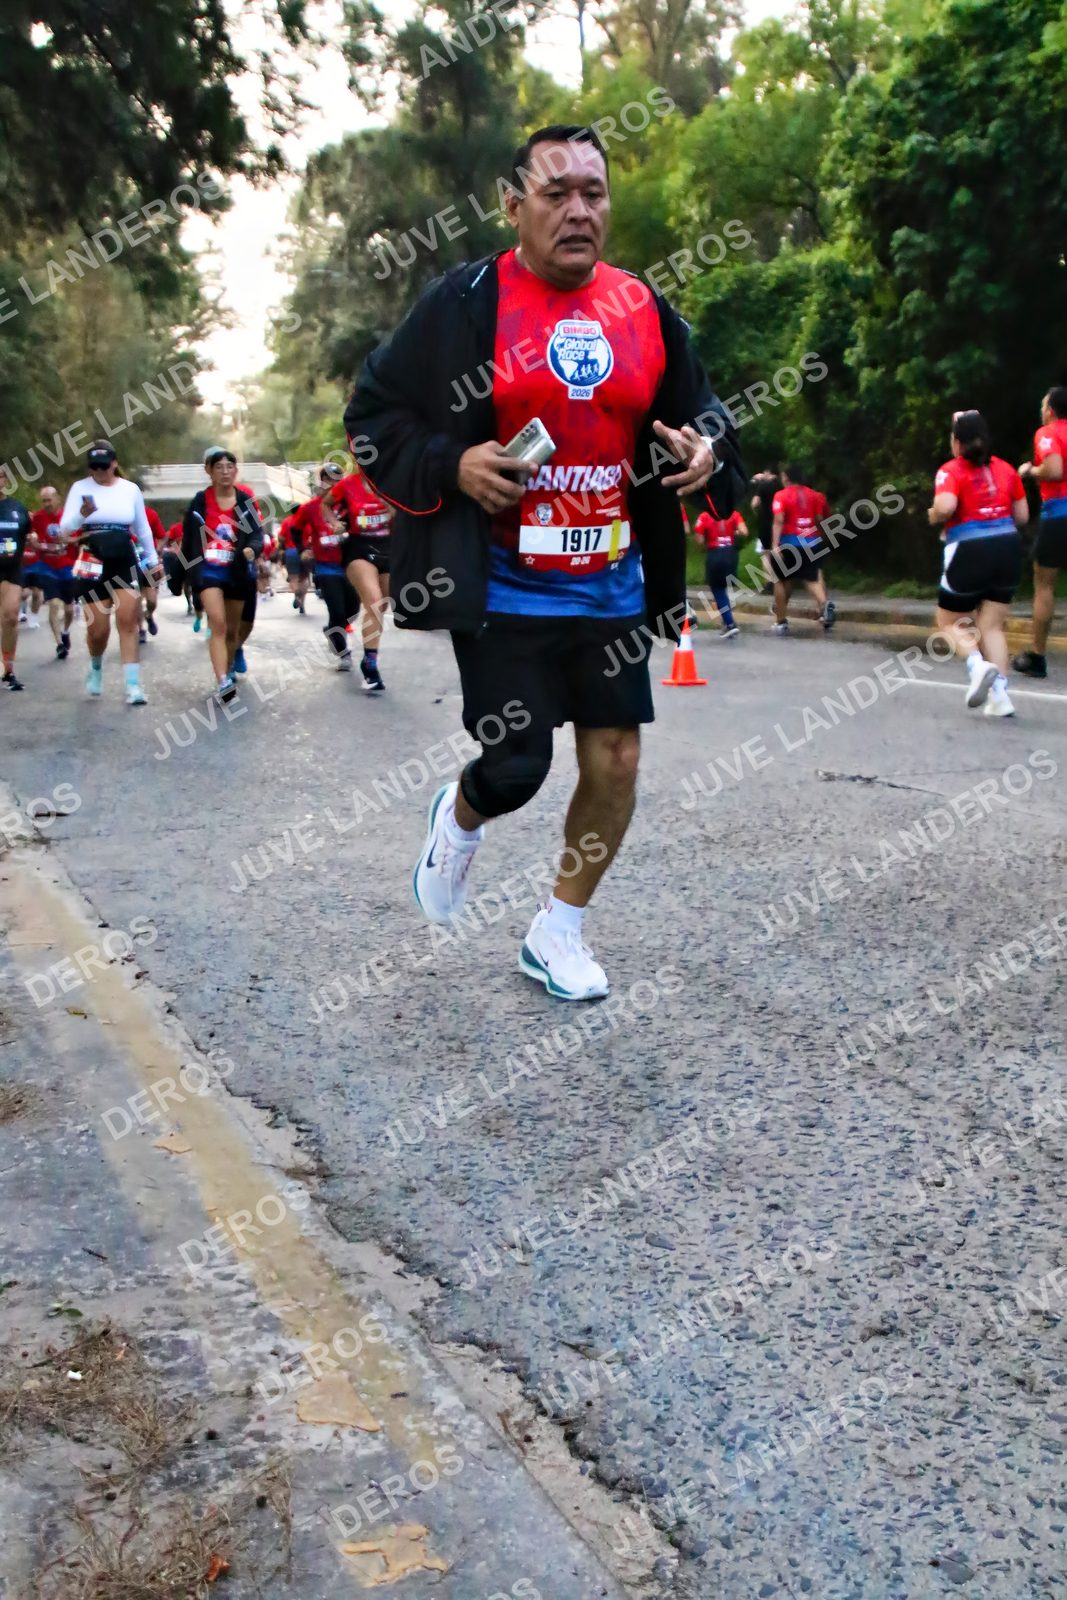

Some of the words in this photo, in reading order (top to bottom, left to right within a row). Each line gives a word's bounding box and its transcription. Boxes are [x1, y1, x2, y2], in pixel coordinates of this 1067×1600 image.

[563, 326, 597, 335] BIMBO
[564, 338, 598, 351] Global
[558, 349, 585, 360] Race
[571, 388, 591, 398] 2026
[561, 528, 602, 553] 1917
